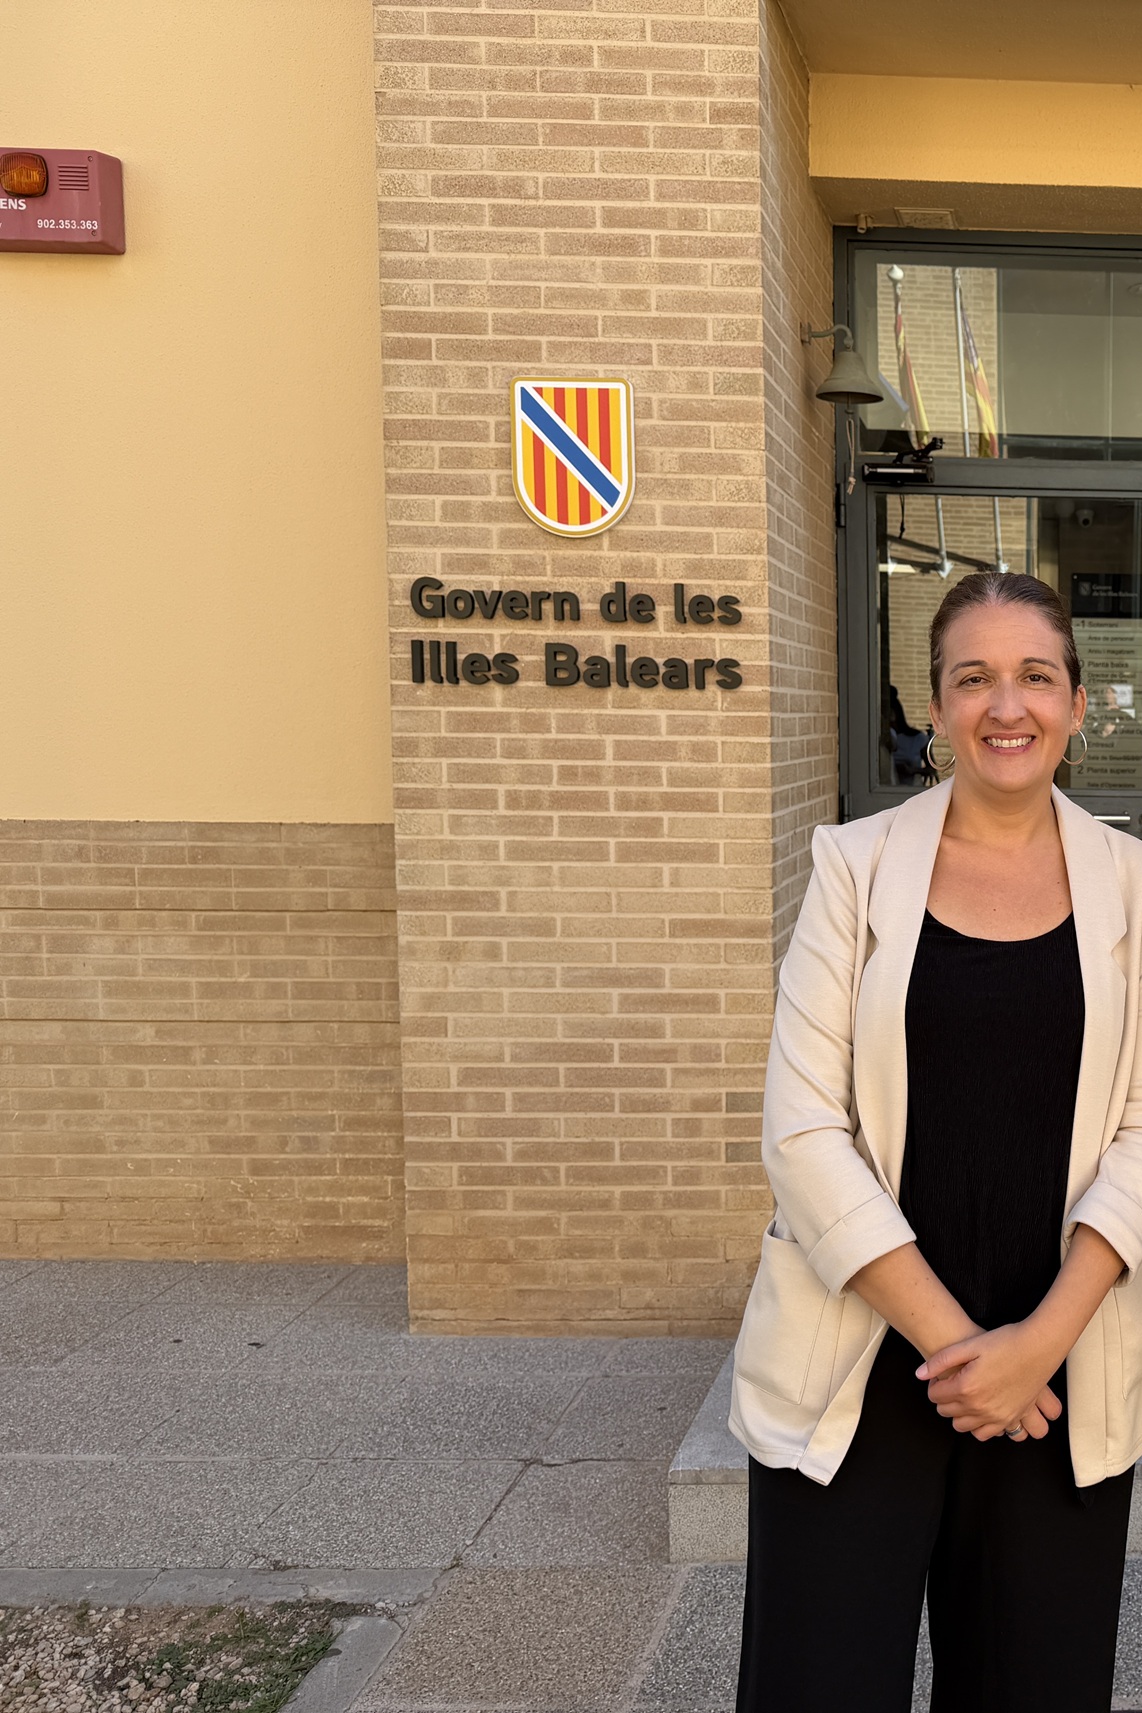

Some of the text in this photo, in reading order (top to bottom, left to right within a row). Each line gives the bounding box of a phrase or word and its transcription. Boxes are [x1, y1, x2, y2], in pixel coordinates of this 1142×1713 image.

[37, 219, 98, 230] 902.353.363
[410, 577, 743, 625] Govern de les
[410, 639, 743, 690] Illes Balears
[1110, 661, 1129, 669] baixa
[1077, 766, 1084, 774] 2
